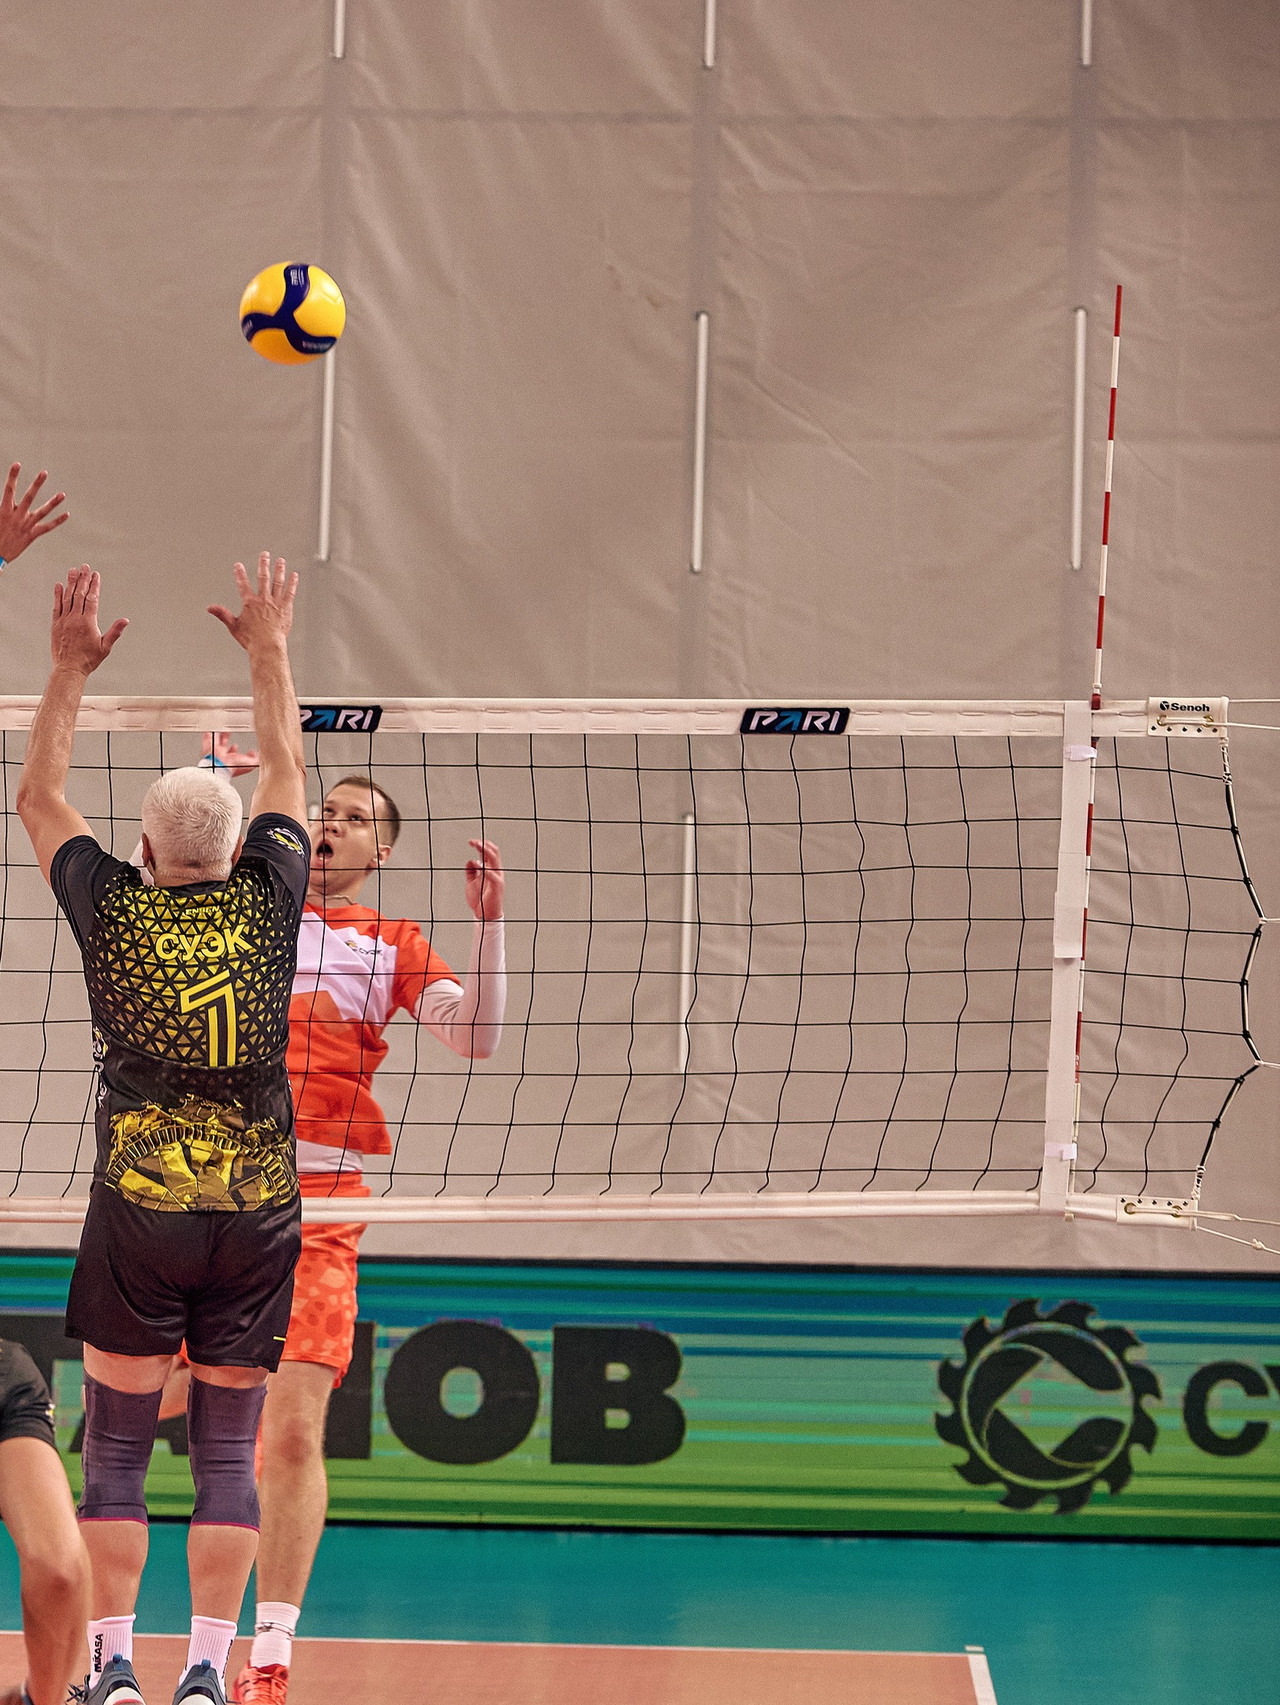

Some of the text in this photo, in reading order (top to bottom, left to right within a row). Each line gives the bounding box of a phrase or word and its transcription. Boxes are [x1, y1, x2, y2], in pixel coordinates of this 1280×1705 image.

[749, 710, 840, 731] PARI
[1171, 703, 1210, 712] Senoh
[155, 923, 253, 961] СУЭК
[180, 968, 237, 1067] 1
